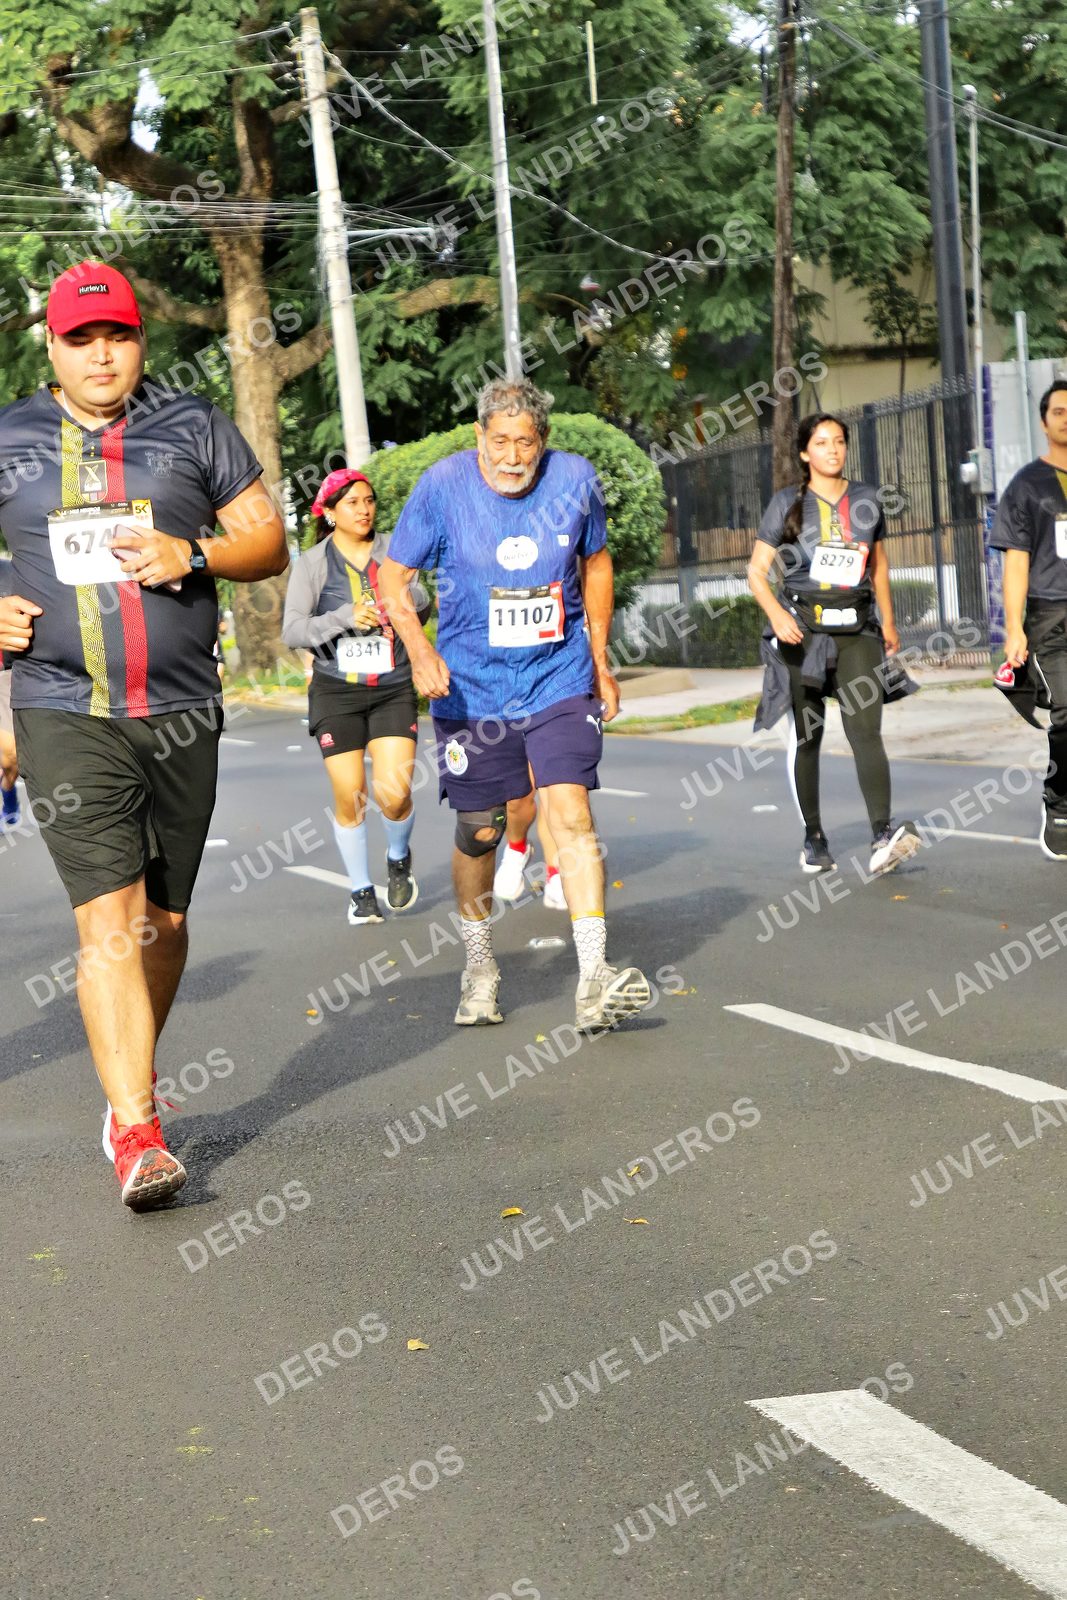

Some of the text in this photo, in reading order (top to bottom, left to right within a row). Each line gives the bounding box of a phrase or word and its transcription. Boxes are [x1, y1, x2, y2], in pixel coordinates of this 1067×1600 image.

[79, 284, 100, 294] Hurley
[820, 553, 854, 568] 8279
[494, 604, 554, 626] 11107
[345, 641, 381, 658] 8341
